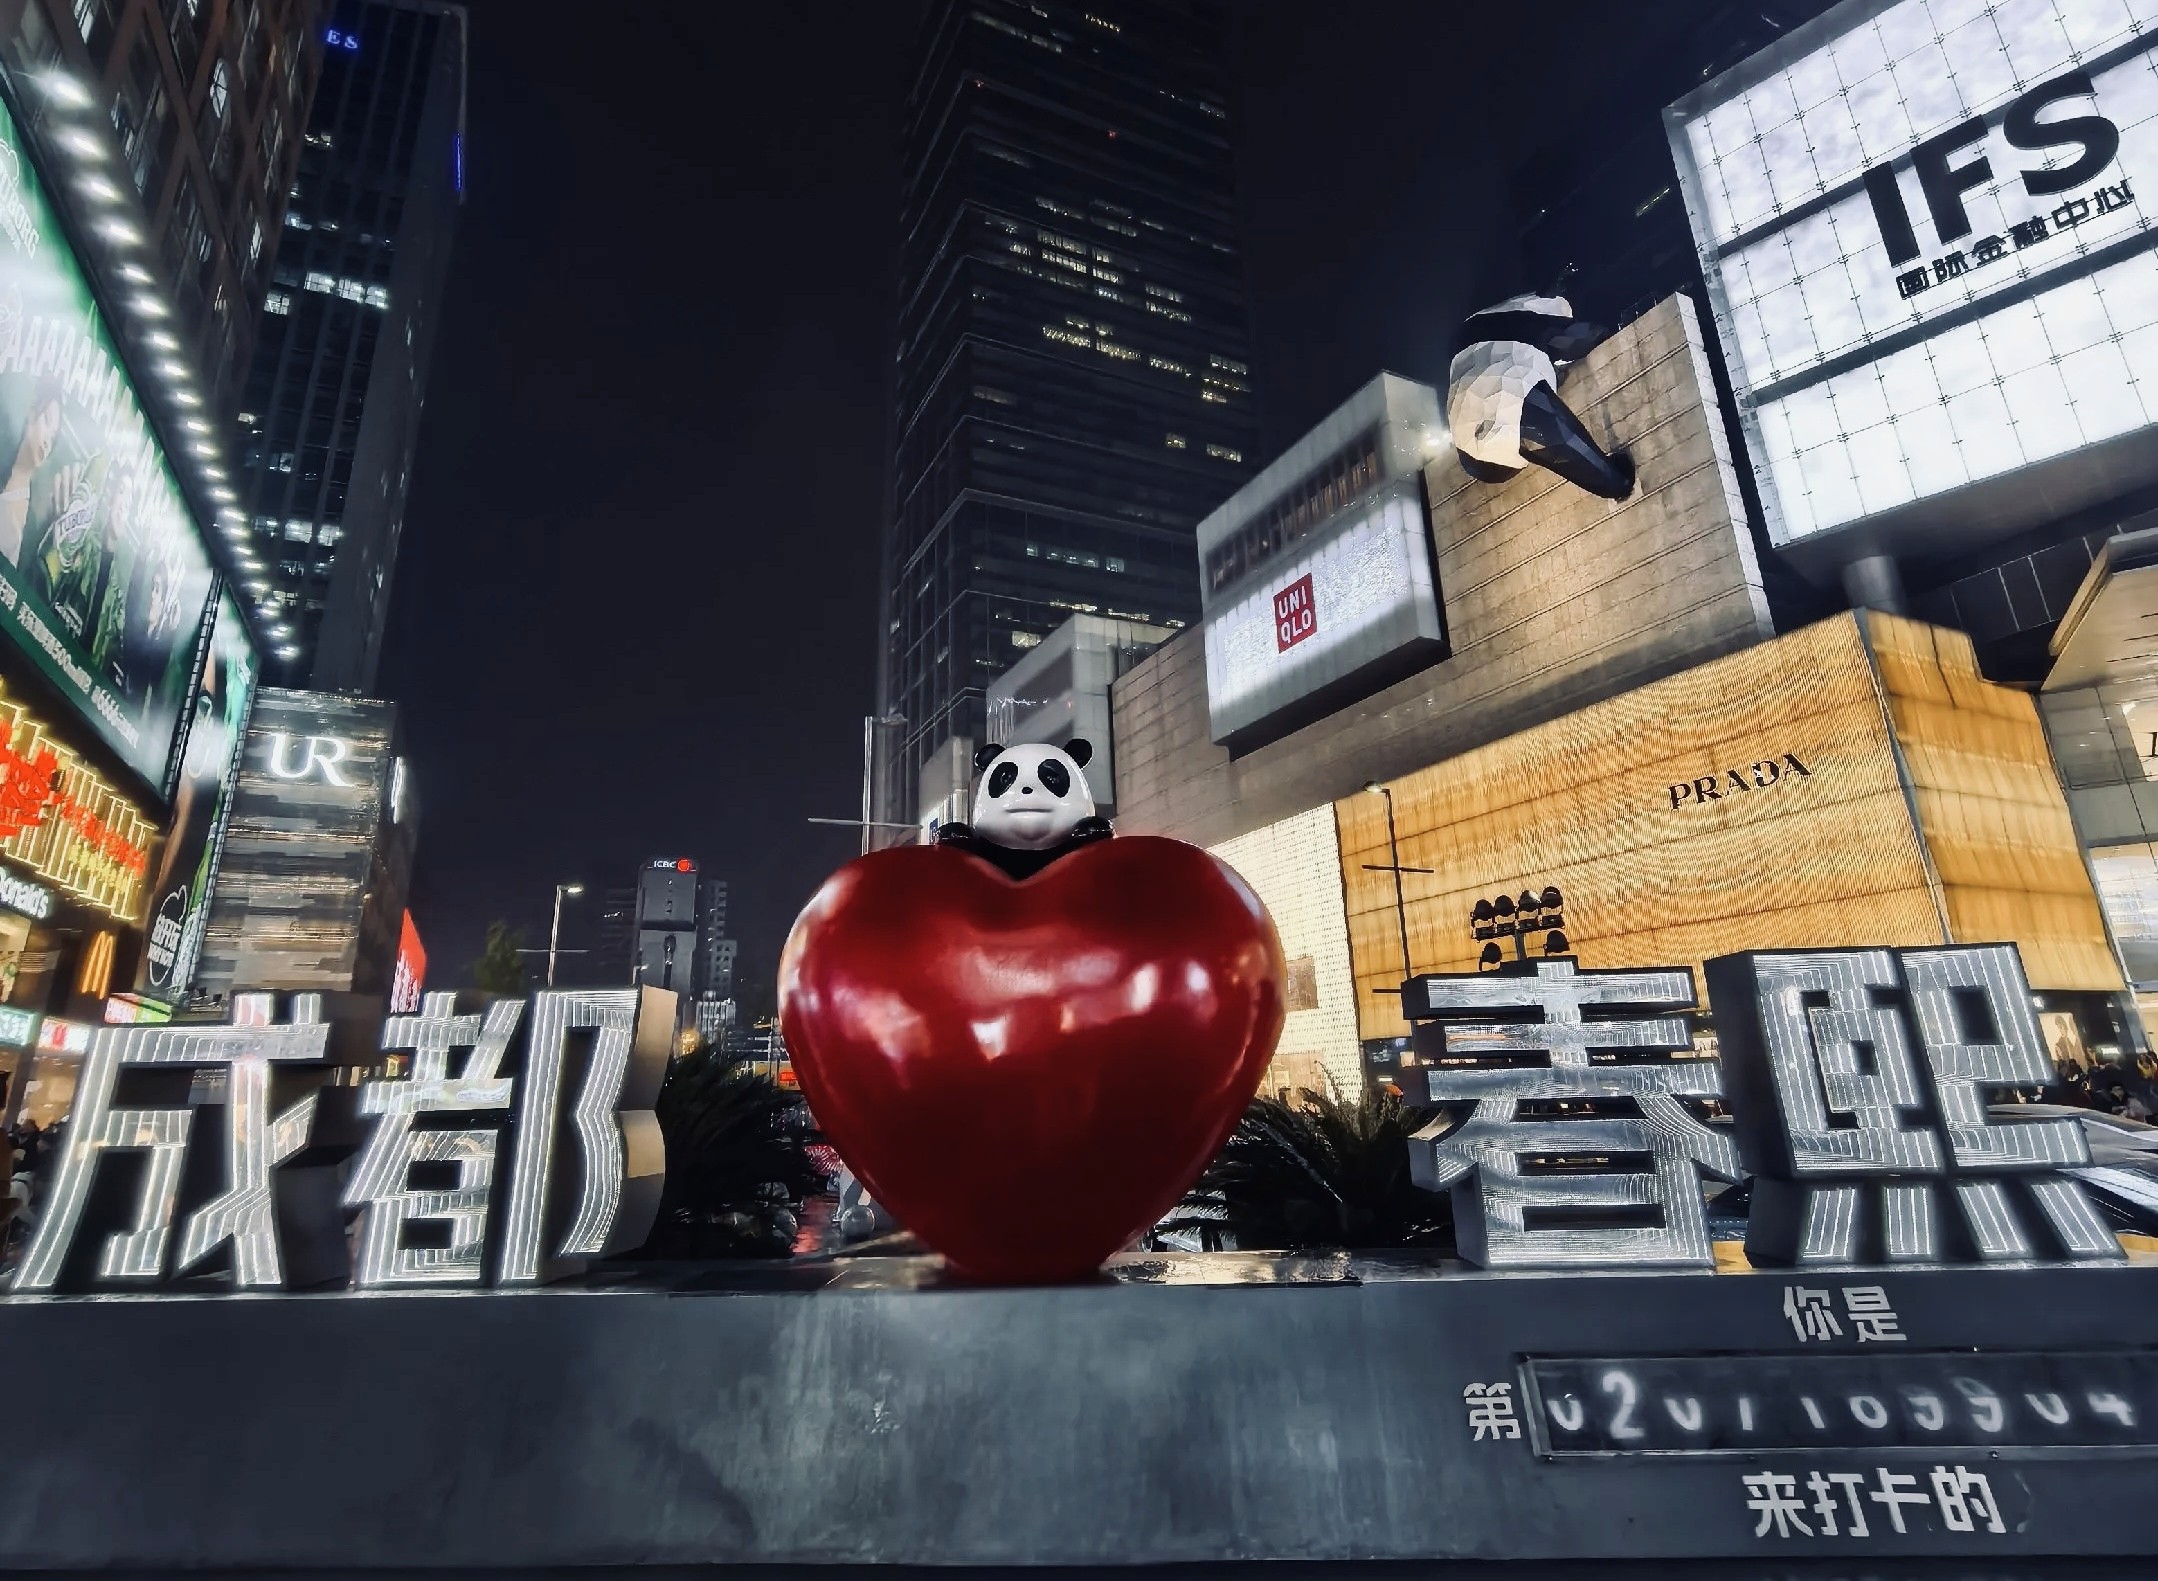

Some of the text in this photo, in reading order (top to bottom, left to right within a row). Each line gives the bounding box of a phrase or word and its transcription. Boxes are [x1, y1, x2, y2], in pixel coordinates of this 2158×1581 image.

[1862, 71, 2120, 268] IFS
[1278, 585, 1307, 619] UNI
[1280, 608, 1312, 644] QLO
[270, 732, 356, 787] UR
[1668, 752, 1812, 812] PRADA
[653, 860, 677, 868] ICBC
[8, 941, 2130, 1291] 成都 春熙
[1783, 1285, 1908, 1343] 你是
[1462, 1382, 1522, 1442] 第
[1742, 1465, 2007, 1538] 来打卡的
